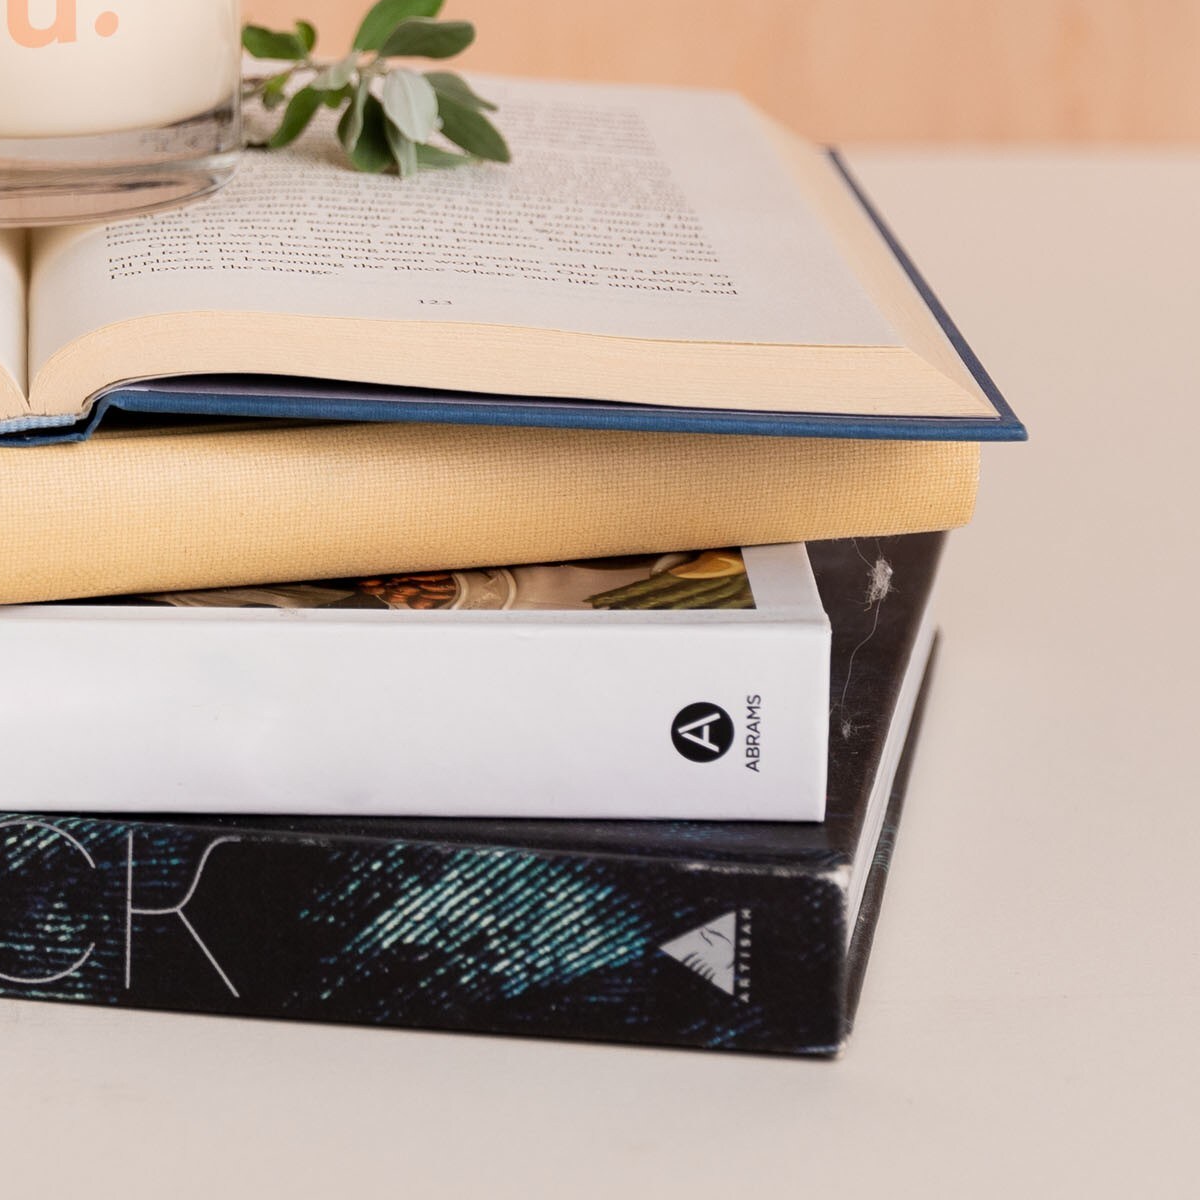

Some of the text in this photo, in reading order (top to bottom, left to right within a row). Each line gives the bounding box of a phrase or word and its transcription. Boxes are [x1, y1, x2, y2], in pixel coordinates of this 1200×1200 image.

[109, 252, 151, 263] land
[341, 254, 425, 263] between
[495, 264, 548, 273] trips.
[608, 275, 705, 286] driveway,
[280, 242, 379, 253] becoming
[473, 256, 542, 264] anchor
[109, 262, 132, 271] all
[143, 258, 211, 266] places,
[245, 256, 344, 268] becoming
[454, 269, 515, 277] where
[608, 283, 692, 294] unfolds,
[111, 271, 141, 280] I'm
[260, 266, 339, 276] change.
[677, 711, 721, 754] A
[745, 694, 762, 773] ABRAMS
